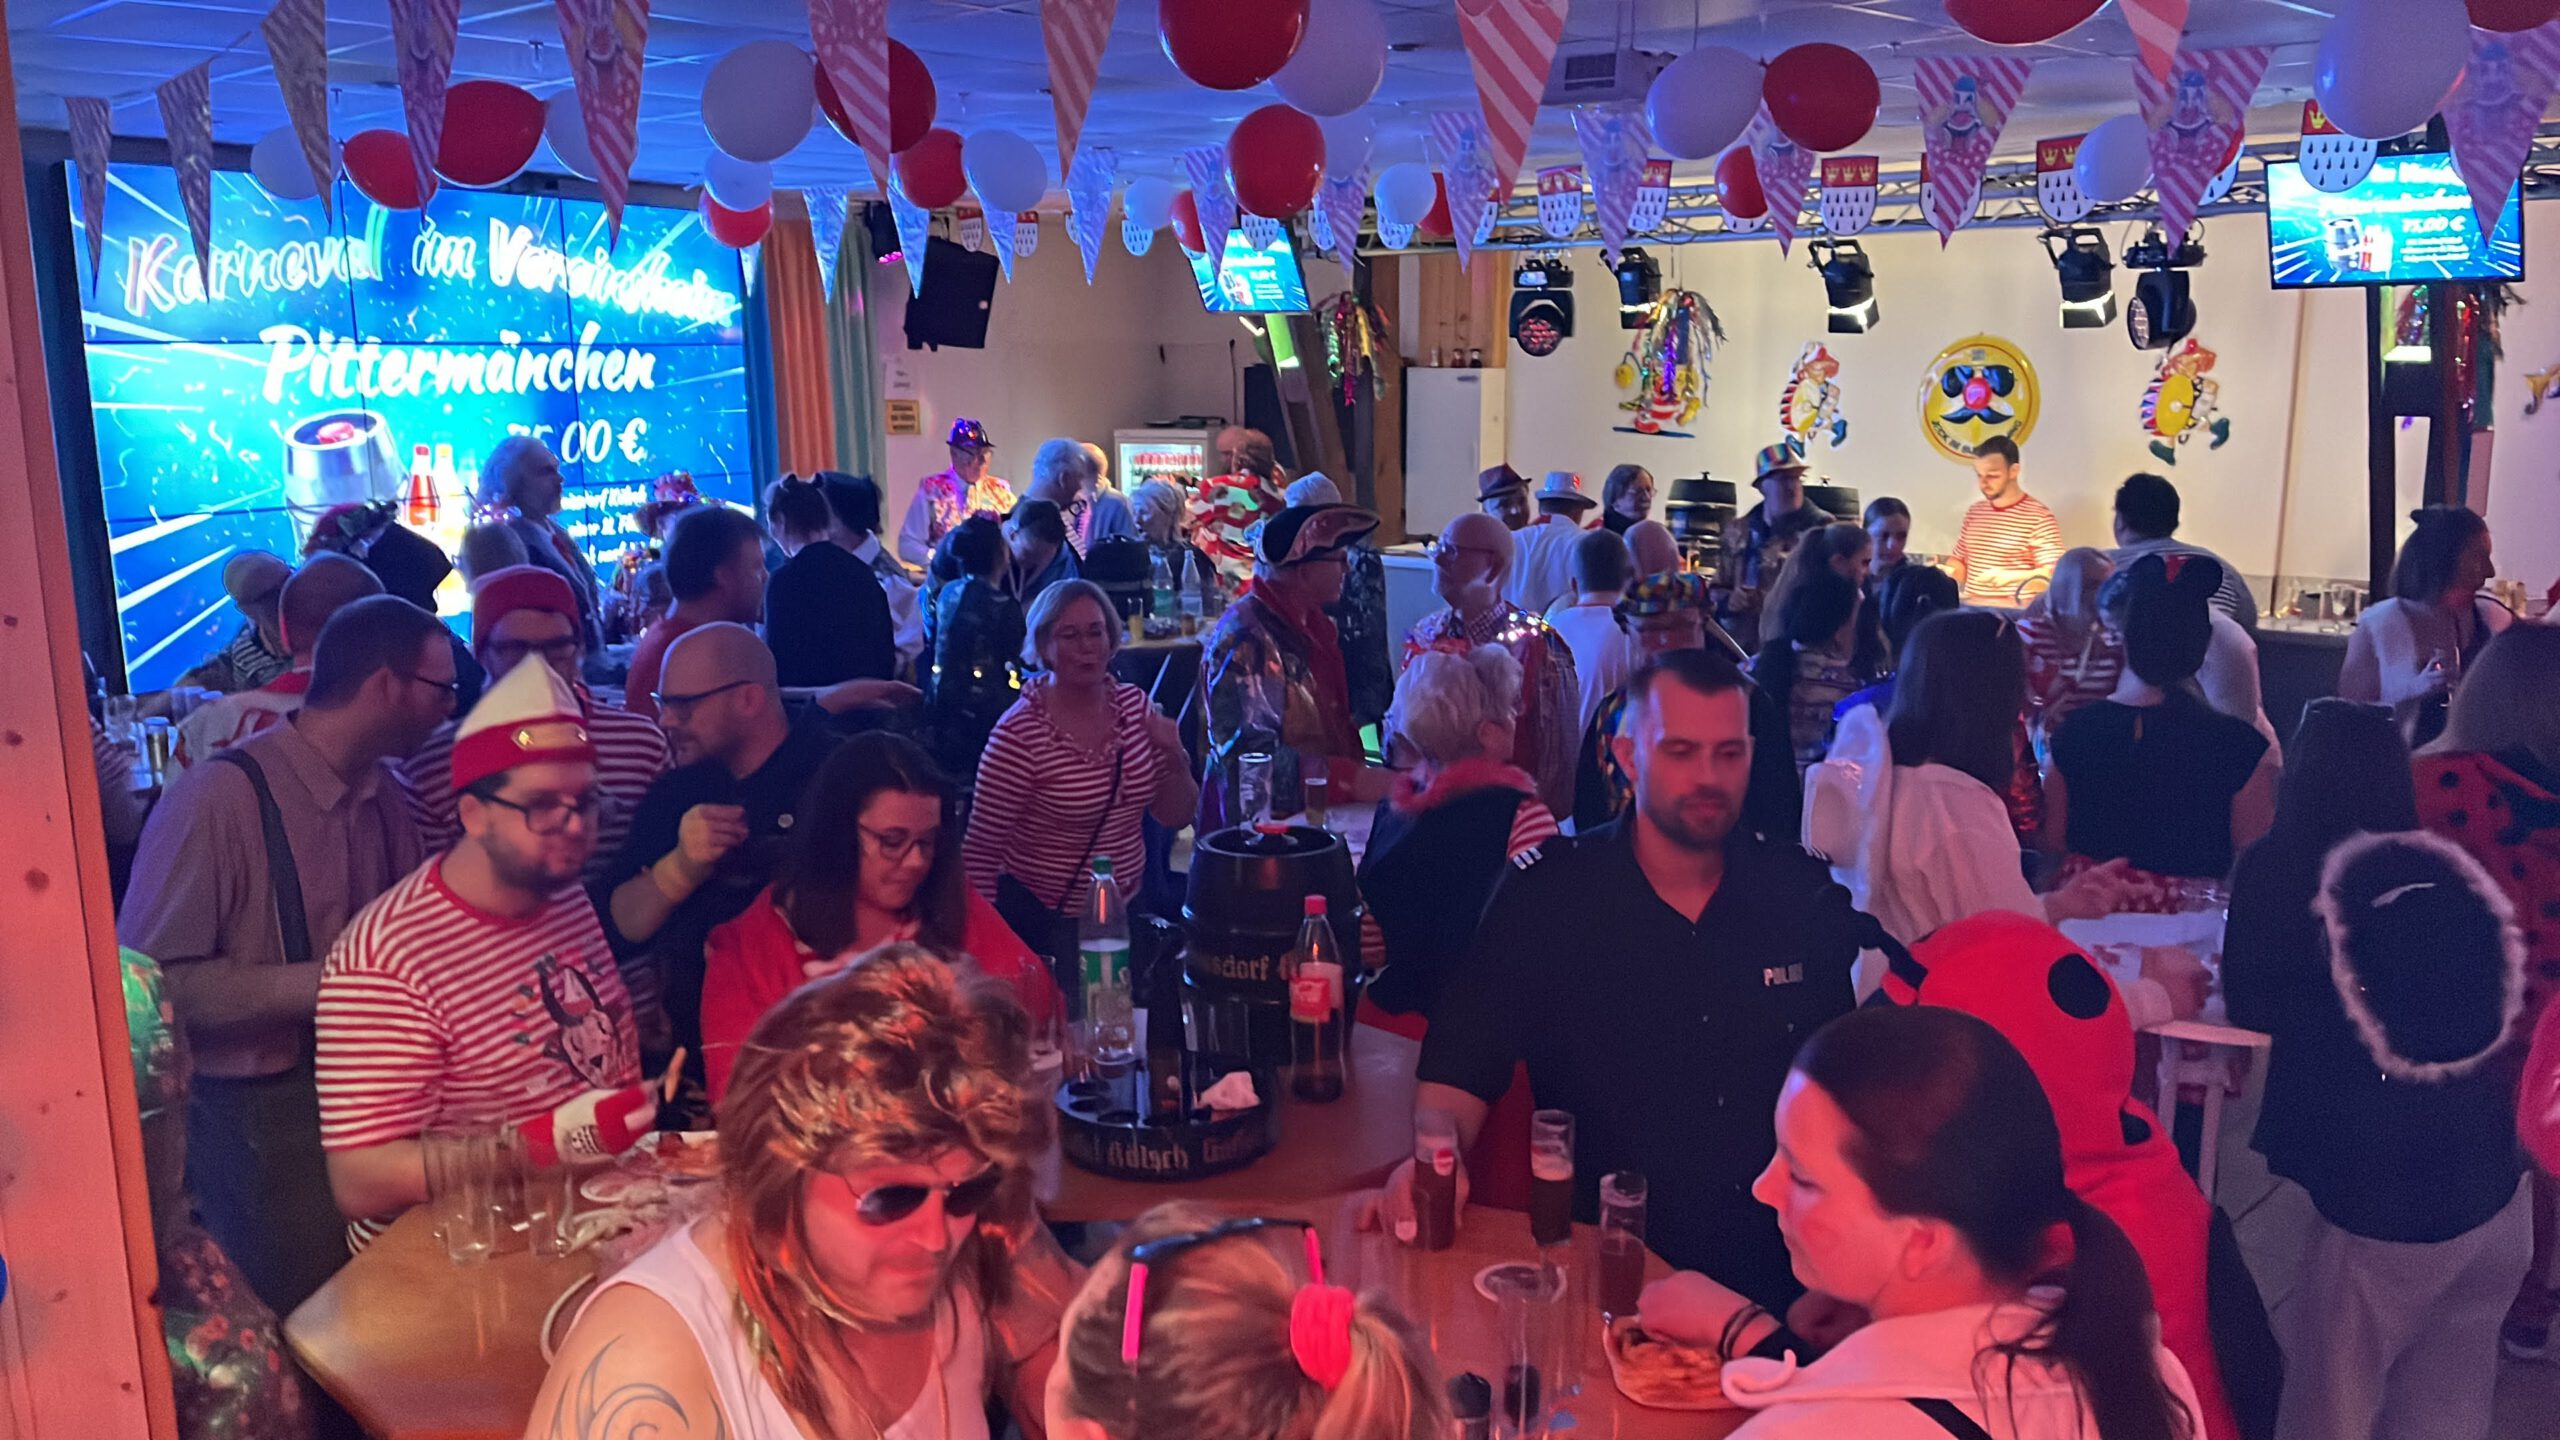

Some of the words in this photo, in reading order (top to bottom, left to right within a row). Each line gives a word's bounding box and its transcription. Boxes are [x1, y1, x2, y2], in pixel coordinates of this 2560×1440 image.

[412, 215, 476, 278] im
[258, 320, 656, 403] Pittermänchen
[616, 417, 648, 463] €
